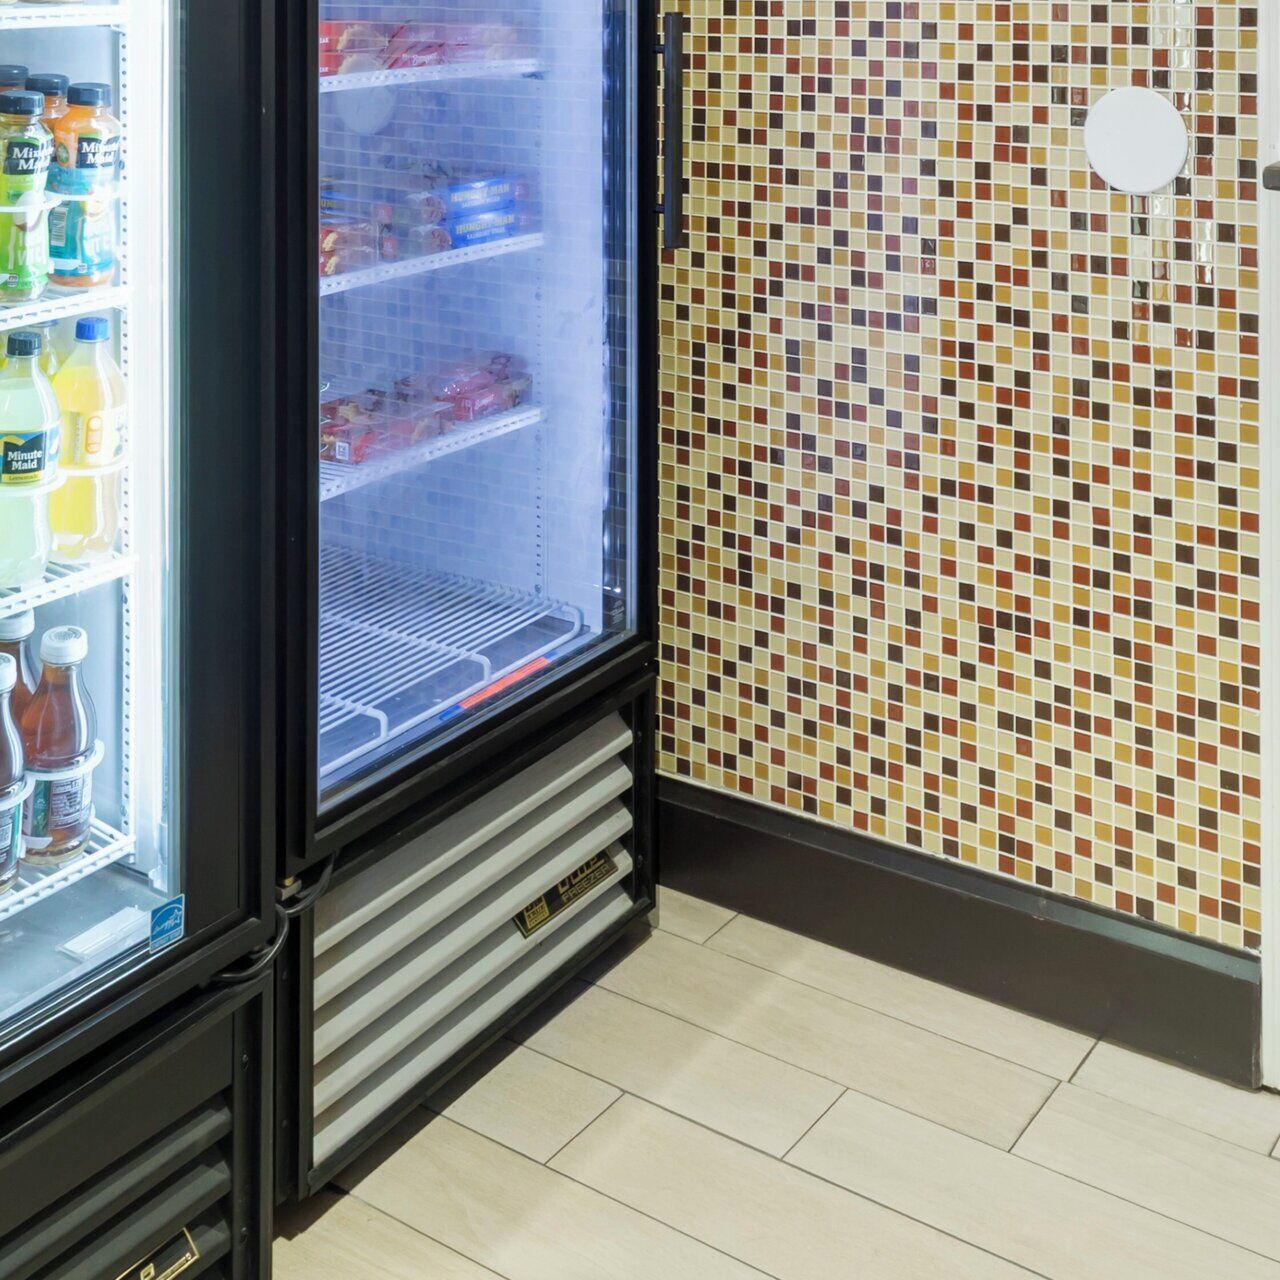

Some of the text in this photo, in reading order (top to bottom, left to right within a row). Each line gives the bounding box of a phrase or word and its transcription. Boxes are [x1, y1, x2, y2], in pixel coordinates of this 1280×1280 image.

[7, 449, 43, 461] Minute
[11, 459, 38, 470] Maid
[561, 864, 609, 903] FREEZER
